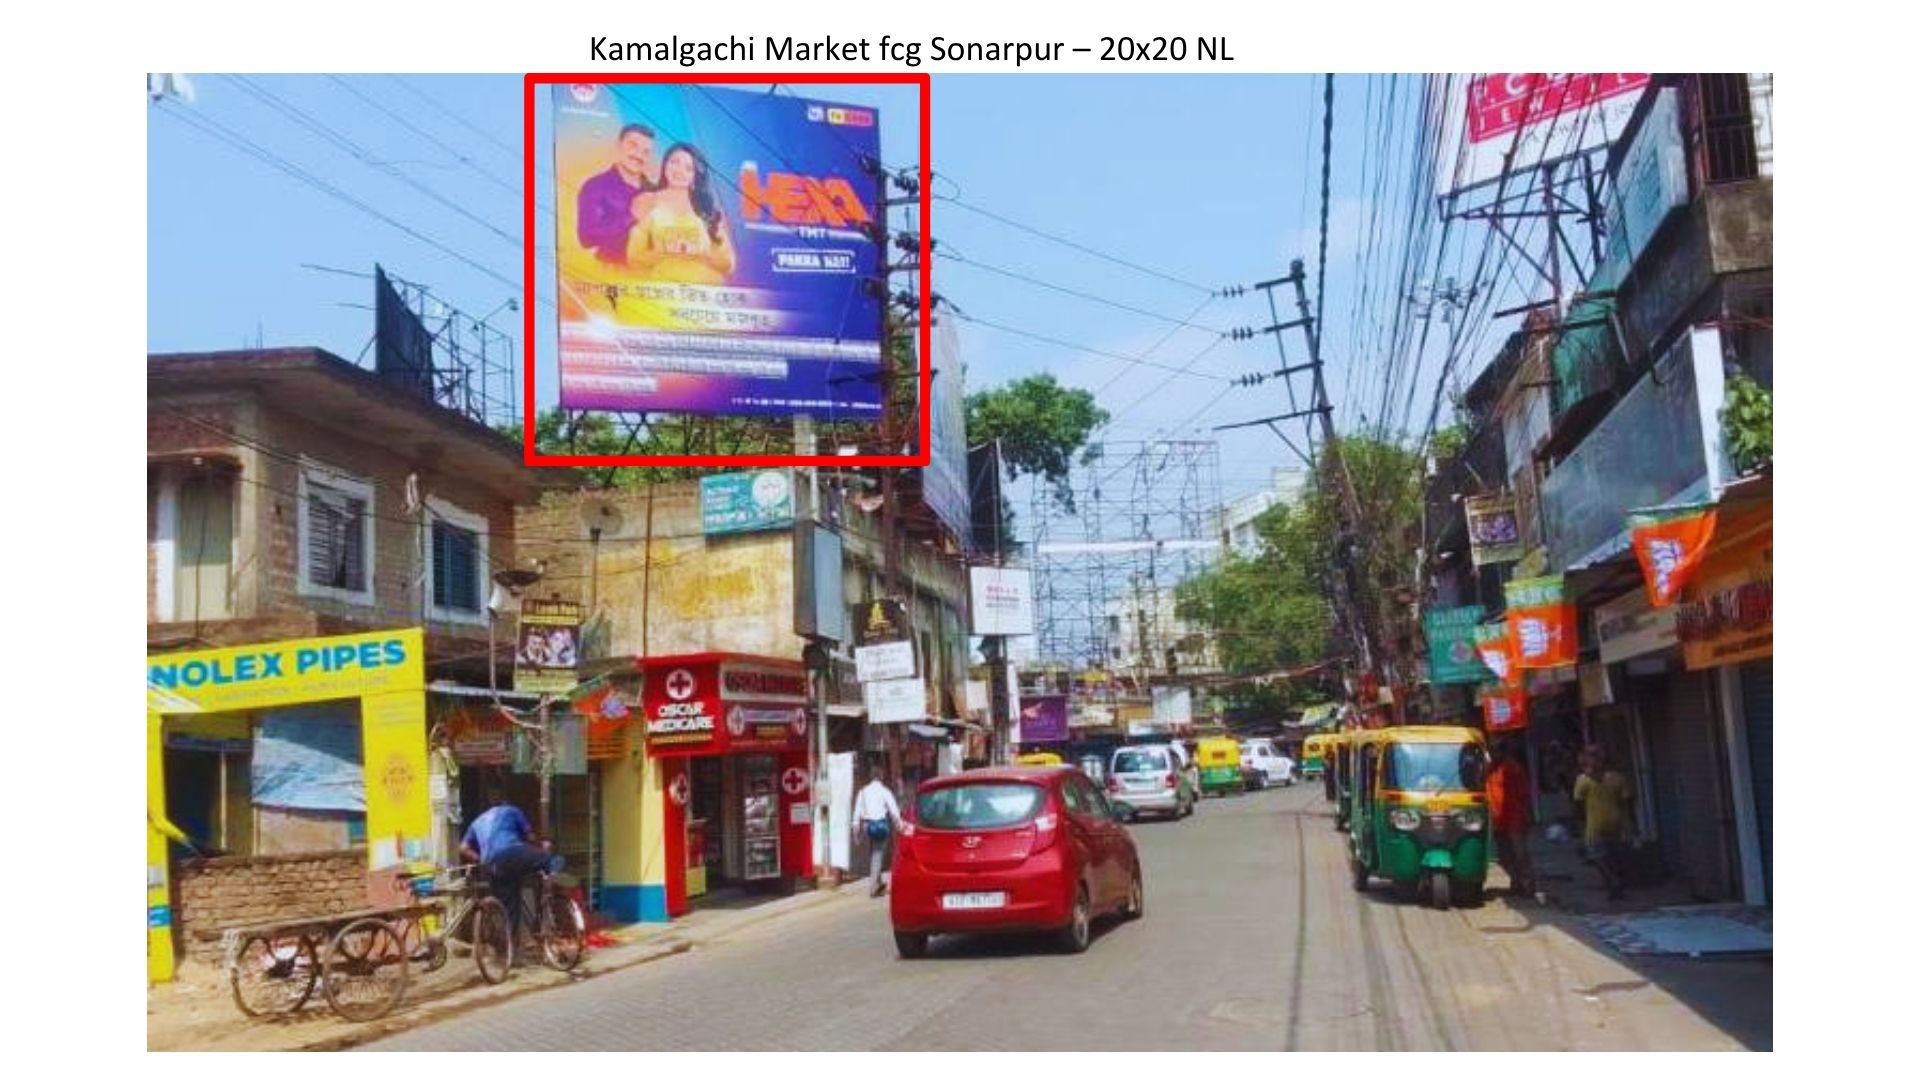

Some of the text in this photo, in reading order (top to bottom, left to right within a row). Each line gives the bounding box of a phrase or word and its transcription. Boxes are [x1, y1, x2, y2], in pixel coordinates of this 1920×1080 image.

[798, 226, 826, 239] TMT
[296, 639, 407, 675] PIPES
[657, 702, 705, 717] OSCAR
[647, 715, 715, 733] MEDICARE
